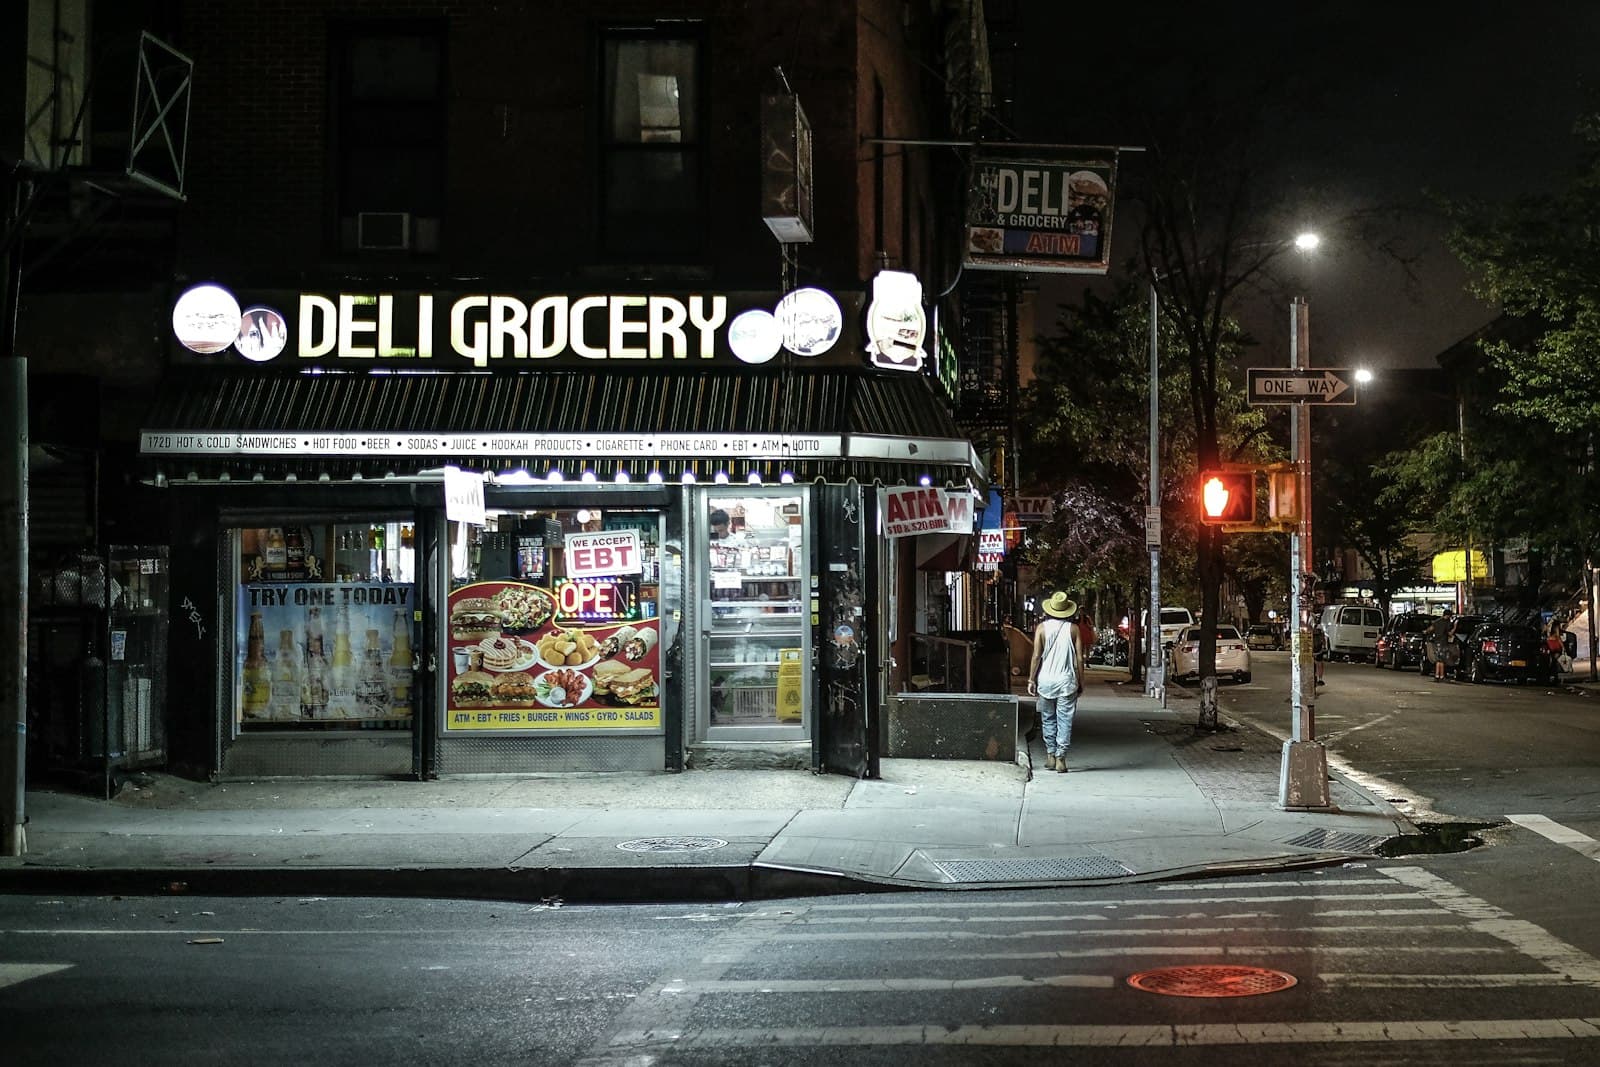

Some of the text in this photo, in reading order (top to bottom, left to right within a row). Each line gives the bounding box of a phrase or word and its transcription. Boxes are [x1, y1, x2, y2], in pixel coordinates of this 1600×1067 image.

[997, 168, 1070, 216] DELI
[997, 215, 1067, 229] & GROCERY
[1026, 232, 1080, 256] ATM
[298, 294, 728, 367] DELI GROCERY
[1264, 379, 1338, 395] ONE WAY
[177, 437, 194, 449] HOT
[197, 437, 204, 449] &
[207, 437, 231, 449] COLD
[236, 437, 297, 449] SANDWICHES
[313, 437, 330, 449] HOT
[334, 437, 357, 449] FOOD
[367, 437, 391, 449] BEER
[408, 438, 438, 450] SODAS
[451, 438, 477, 450] JUICE
[492, 438, 529, 450] HOOKAH
[535, 438, 582, 450] PRODUCTS
[597, 438, 644, 450] CIGARETTE
[661, 439, 690, 451] PHONE
[694, 439, 718, 451] CARD
[733, 439, 749, 451] EBT
[762, 439, 780, 451] ATM
[793, 439, 820, 451] LOTTO
[887, 488, 944, 523] ATM
[888, 524, 902, 535] $10
[912, 521, 928, 532] $20
[573, 536, 633, 548] WE ACCEPT
[981, 533, 1002, 542] TM
[573, 545, 633, 571] EBT
[248, 586, 410, 607] TRY ONE TODAY
[560, 583, 630, 614] OPEN
[454, 710, 654, 723] ATM EBT FRIES BURGER WINGS GYRO SALADS
